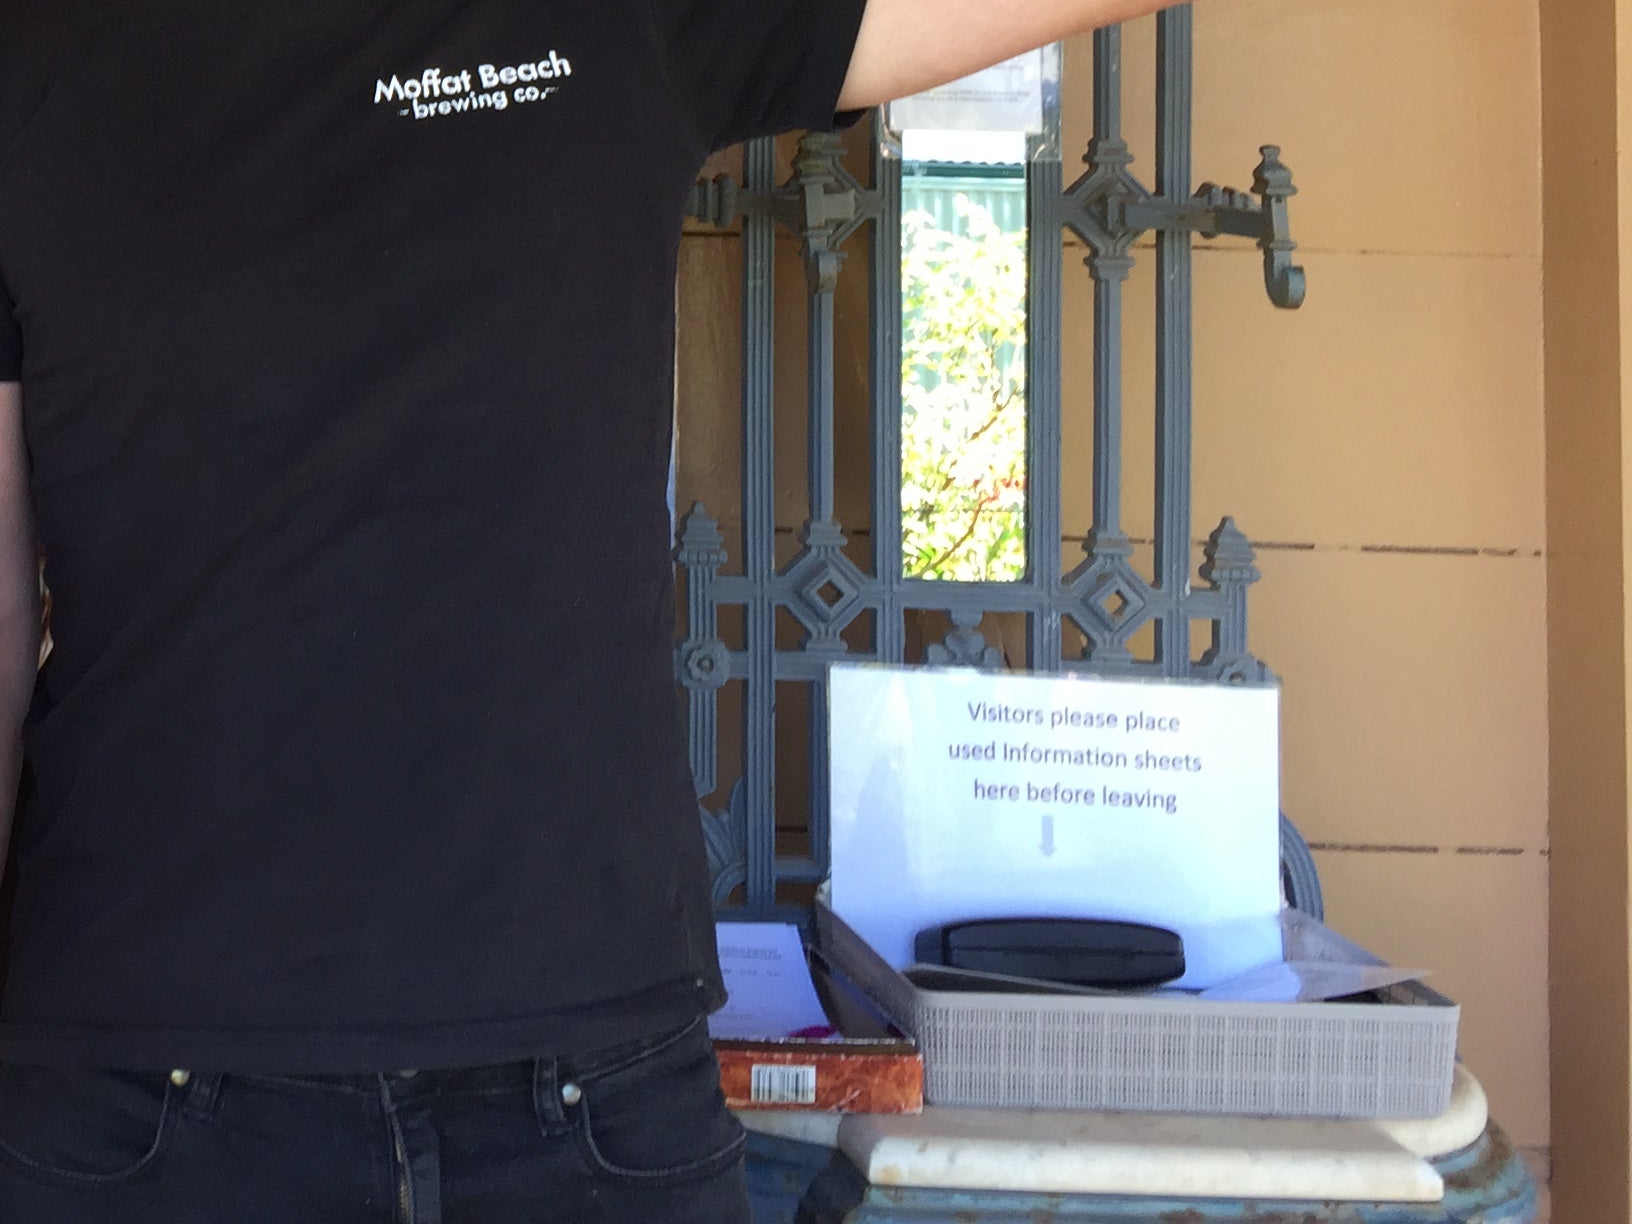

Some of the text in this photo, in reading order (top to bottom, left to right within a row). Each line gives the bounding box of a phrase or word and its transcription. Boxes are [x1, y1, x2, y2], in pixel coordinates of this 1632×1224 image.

[373, 49, 572, 104] Moffat Beach
[412, 90, 508, 120] brewing
[967, 701, 1181, 733] Visitors please place
[948, 740, 1203, 773] used Information sheets
[973, 778, 1178, 815] here before leaving
